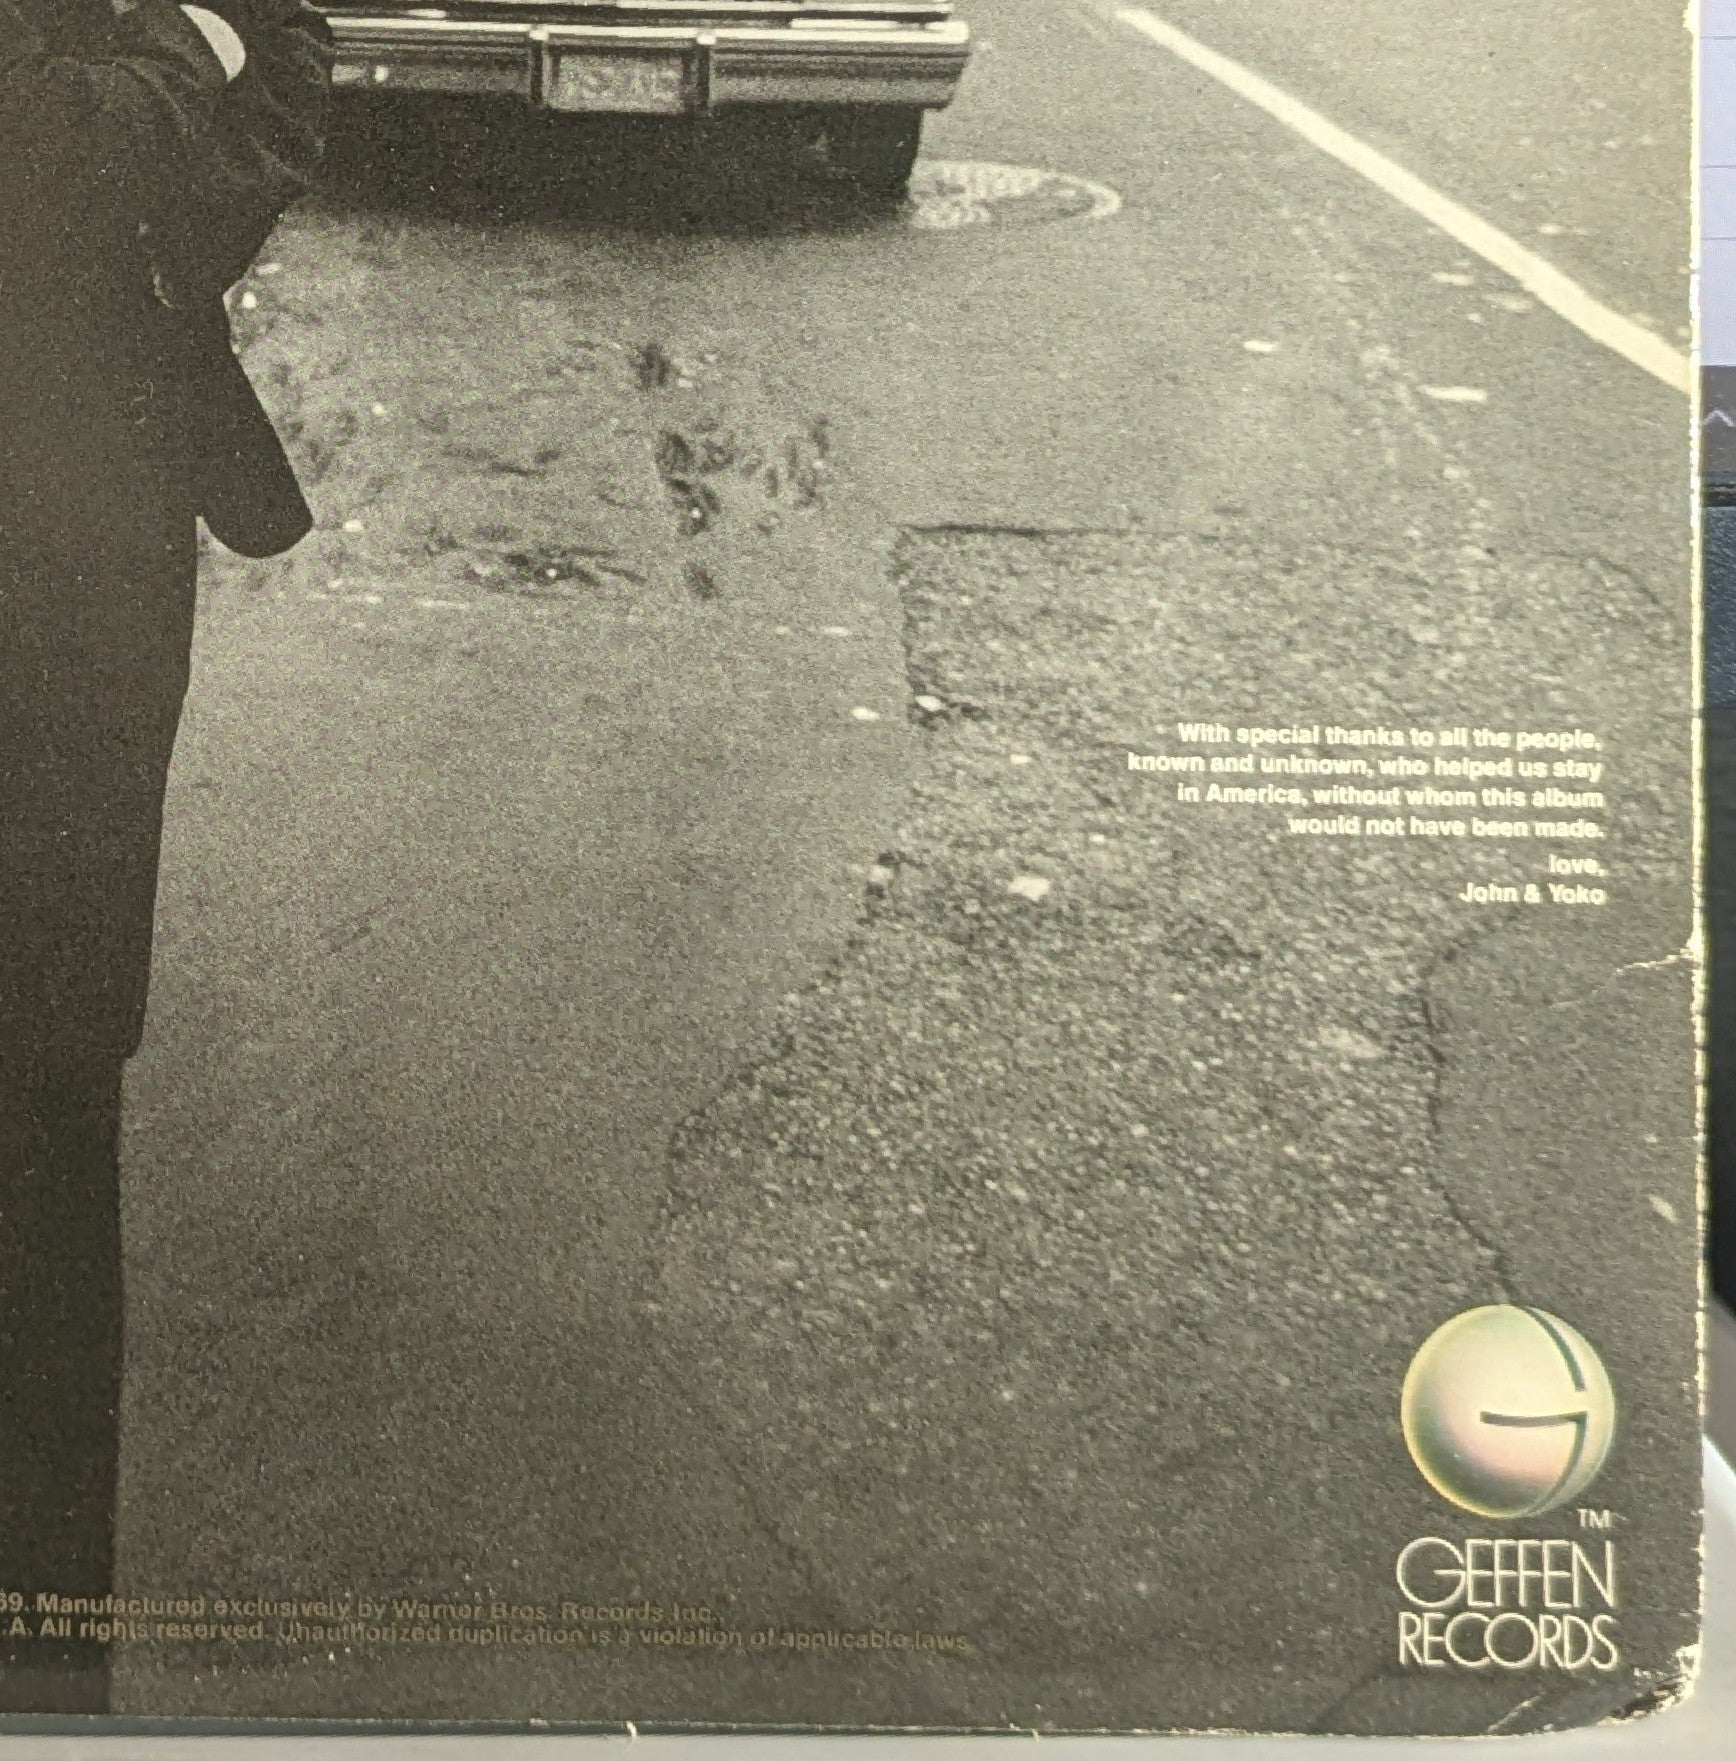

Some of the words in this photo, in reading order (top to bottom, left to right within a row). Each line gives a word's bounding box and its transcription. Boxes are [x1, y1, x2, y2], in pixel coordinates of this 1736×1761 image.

[1177, 722, 1230, 743] With
[1237, 724, 1319, 747] special
[1325, 726, 1404, 746] thanks
[1409, 728, 1434, 747] to
[1439, 727, 1468, 747] all
[1473, 728, 1511, 748] the
[1127, 751, 1205, 771] known
[1210, 754, 1254, 772] and
[1260, 754, 1374, 778] unknown,
[1378, 756, 1428, 775] who
[1434, 757, 1513, 781] helped
[1518, 761, 1547, 778] us
[1553, 759, 1603, 783] stay
[1177, 782, 1199, 802] in
[1206, 783, 1309, 806] America,
[1313, 785, 1400, 805] without
[1405, 786, 1476, 807] whom
[1481, 787, 1526, 807] this
[1532, 787, 1605, 808] album
[1288, 815, 1361, 835] would
[1365, 817, 1405, 836] not
[1410, 816, 1465, 836] have
[1472, 817, 1528, 837] been
[1535, 818, 1605, 838] made.
[1459, 882, 1518, 904] John
[1524, 884, 1540, 904] &
[1547, 882, 1606, 904] Yoko
[1577, 1507, 1612, 1530] TM
[1396, 1536, 1618, 1610] GEFFEN
[37, 1592, 205, 1616] Manufactured
[213, 1594, 349, 1621] exclusively
[358, 1598, 385, 1621] by
[393, 1598, 482, 1620] Warner
[561, 1600, 664, 1621] Records
[40, 1616, 71, 1637] All
[79, 1617, 150, 1642] rights
[1397, 1610, 1620, 1672] RECORDS
